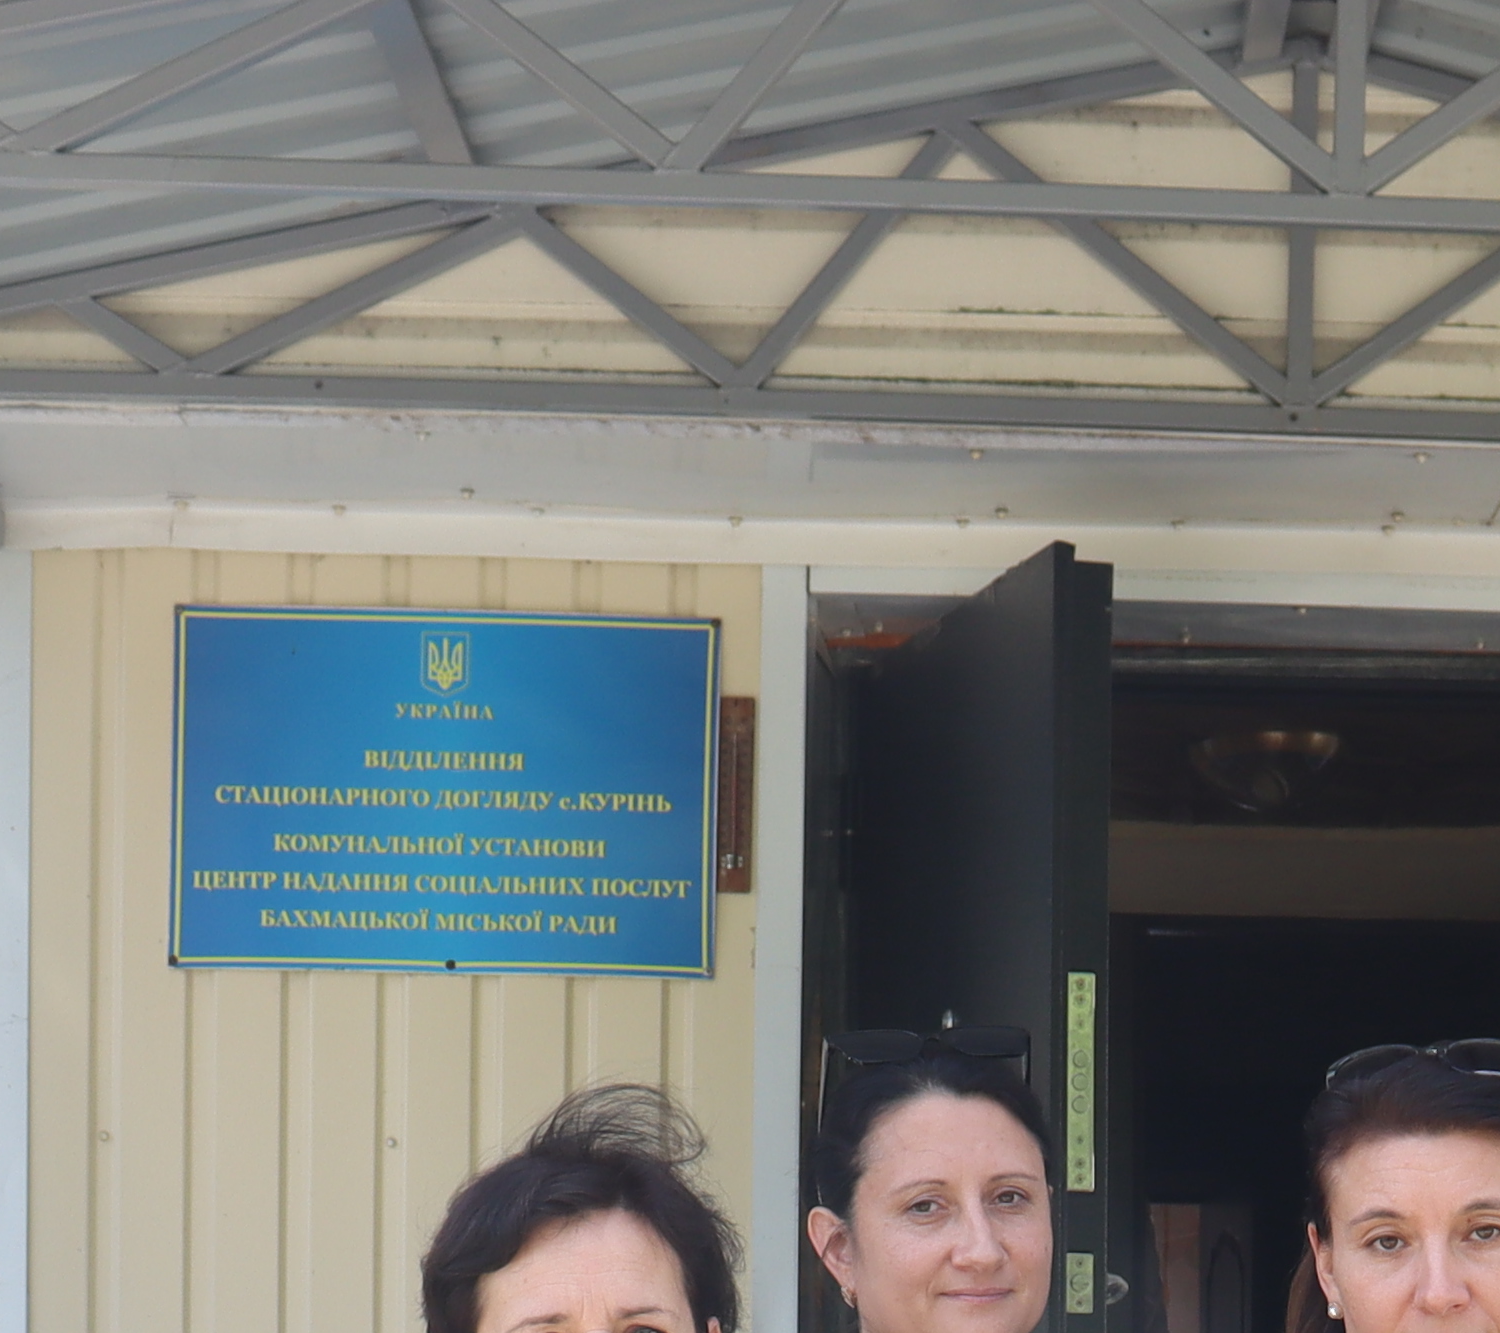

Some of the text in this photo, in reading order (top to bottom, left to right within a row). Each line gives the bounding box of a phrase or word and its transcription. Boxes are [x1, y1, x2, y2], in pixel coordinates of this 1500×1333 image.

[395, 701, 494, 720] УКРАЇНА
[364, 749, 525, 772] ВІДДІЛЕННЯ
[214, 784, 673, 814] СТАЦІОНАРНОГО ДОГЛЯДУ с.КУРІНЬ
[273, 833, 607, 859] КОМУНАЛЬНОЇ УСТАНОВИ
[192, 870, 692, 899] ЦЕНТР НАДАННЯ СОЦІАЛЬНИХ ПОСЛУГ
[260, 908, 618, 936] БАХМАЦЬКОЇ МІСЬКОЇ РАДИ
